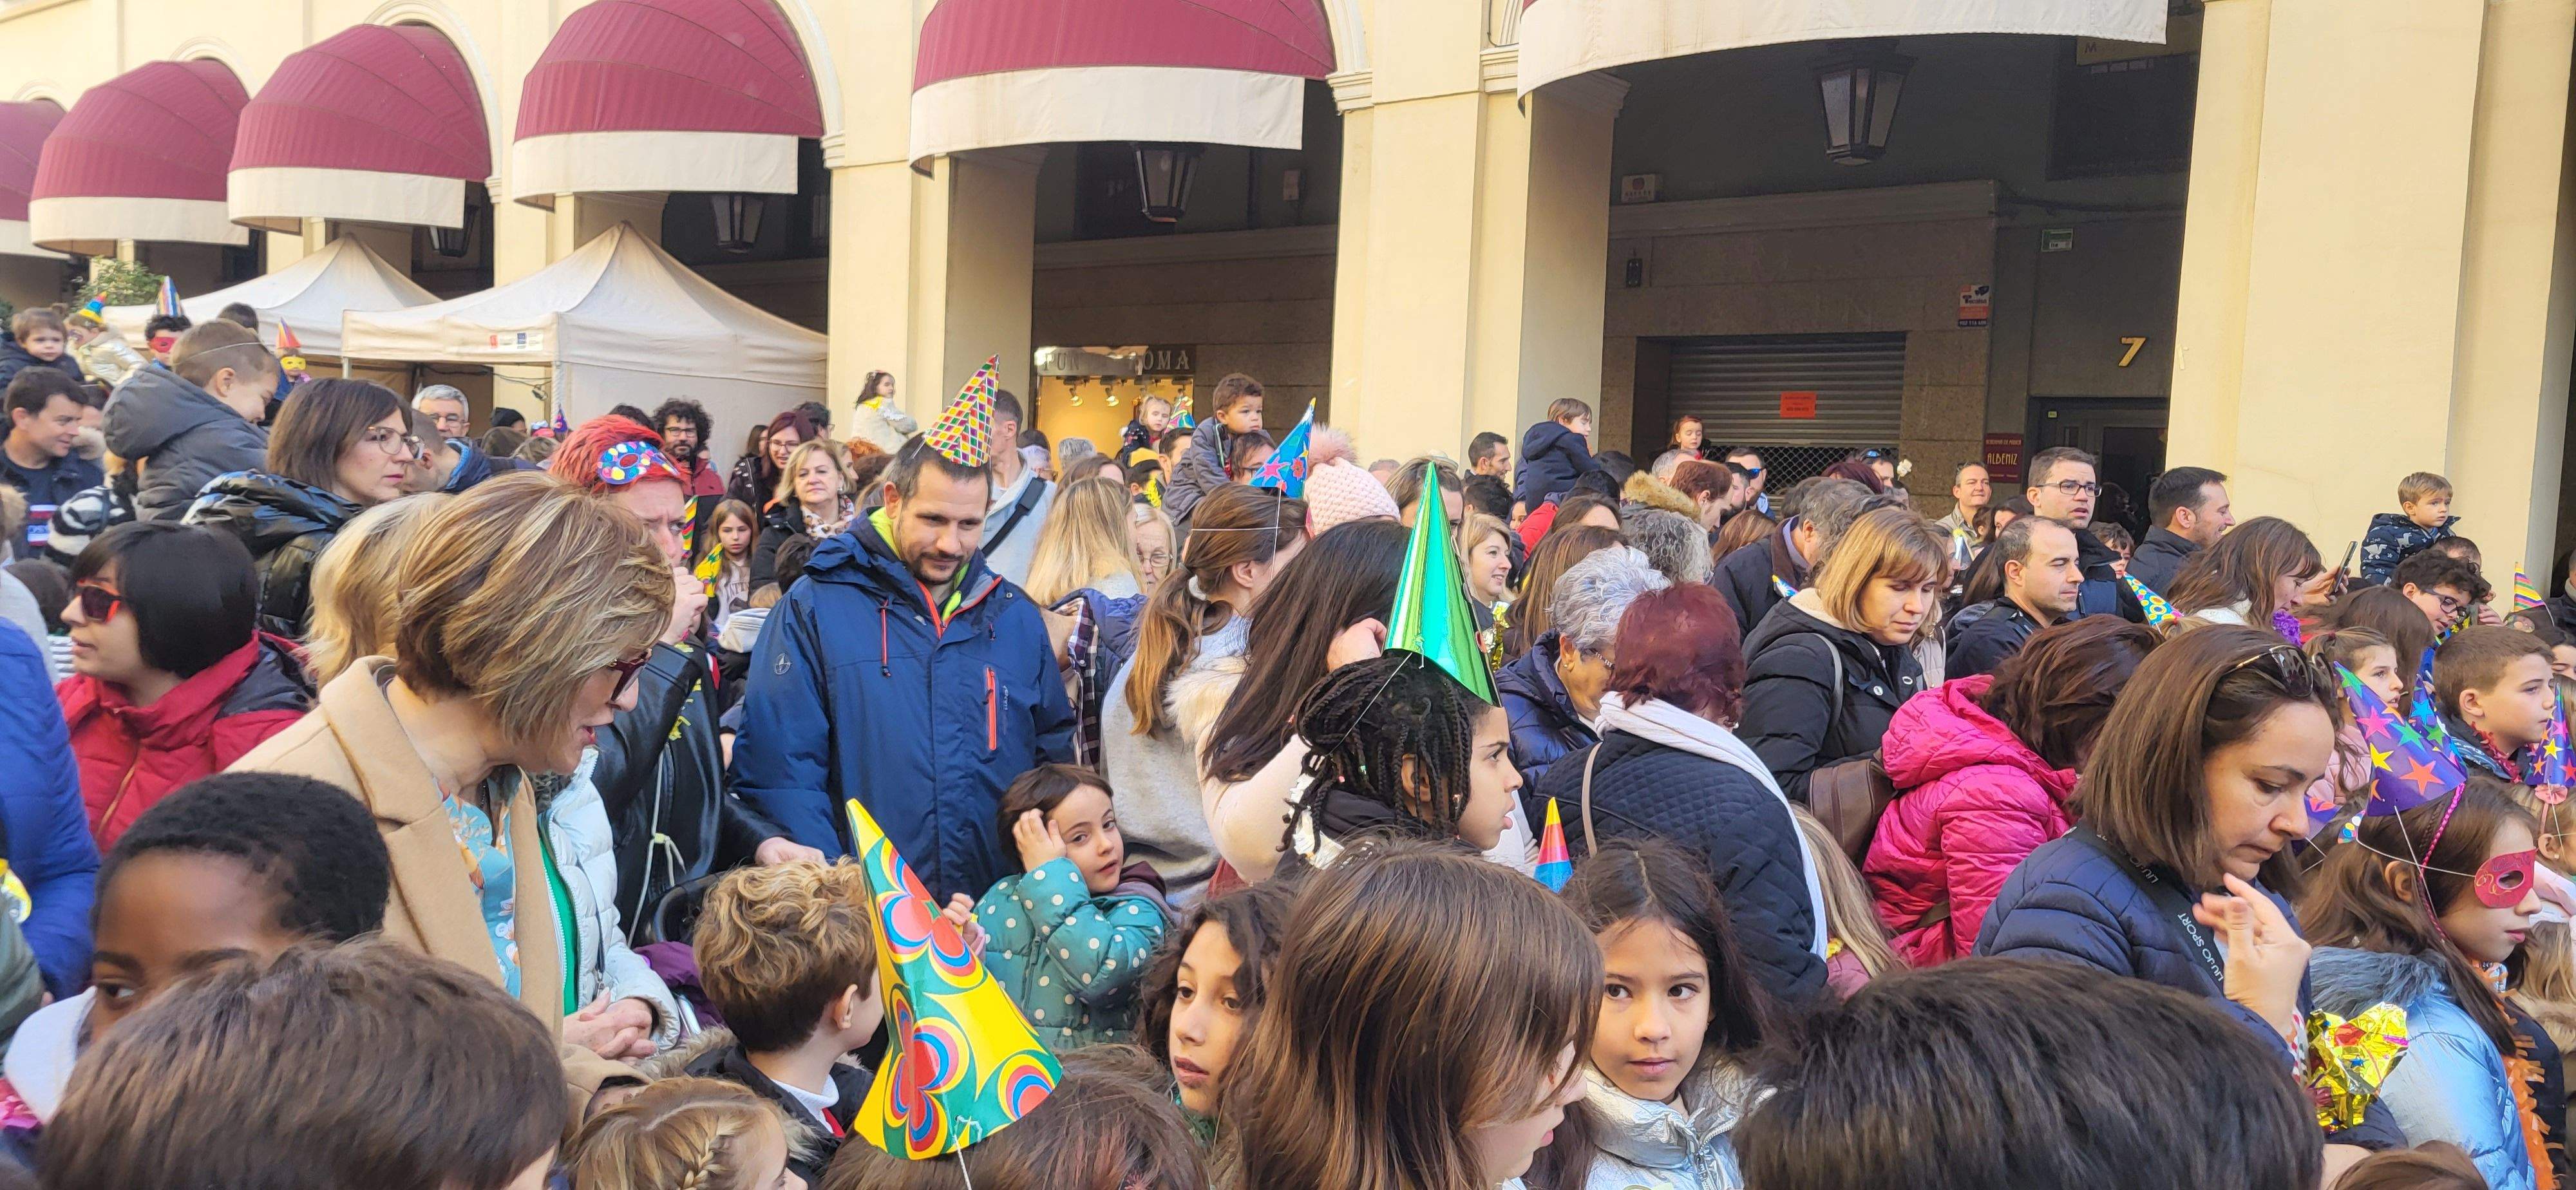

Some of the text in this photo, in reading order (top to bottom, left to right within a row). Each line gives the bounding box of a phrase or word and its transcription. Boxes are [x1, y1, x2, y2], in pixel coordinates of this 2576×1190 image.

[2118, 337, 2146, 366] 7
[1987, 453, 2018, 465] ALBENIZ
[2177, 913, 2204, 947] SPORT
